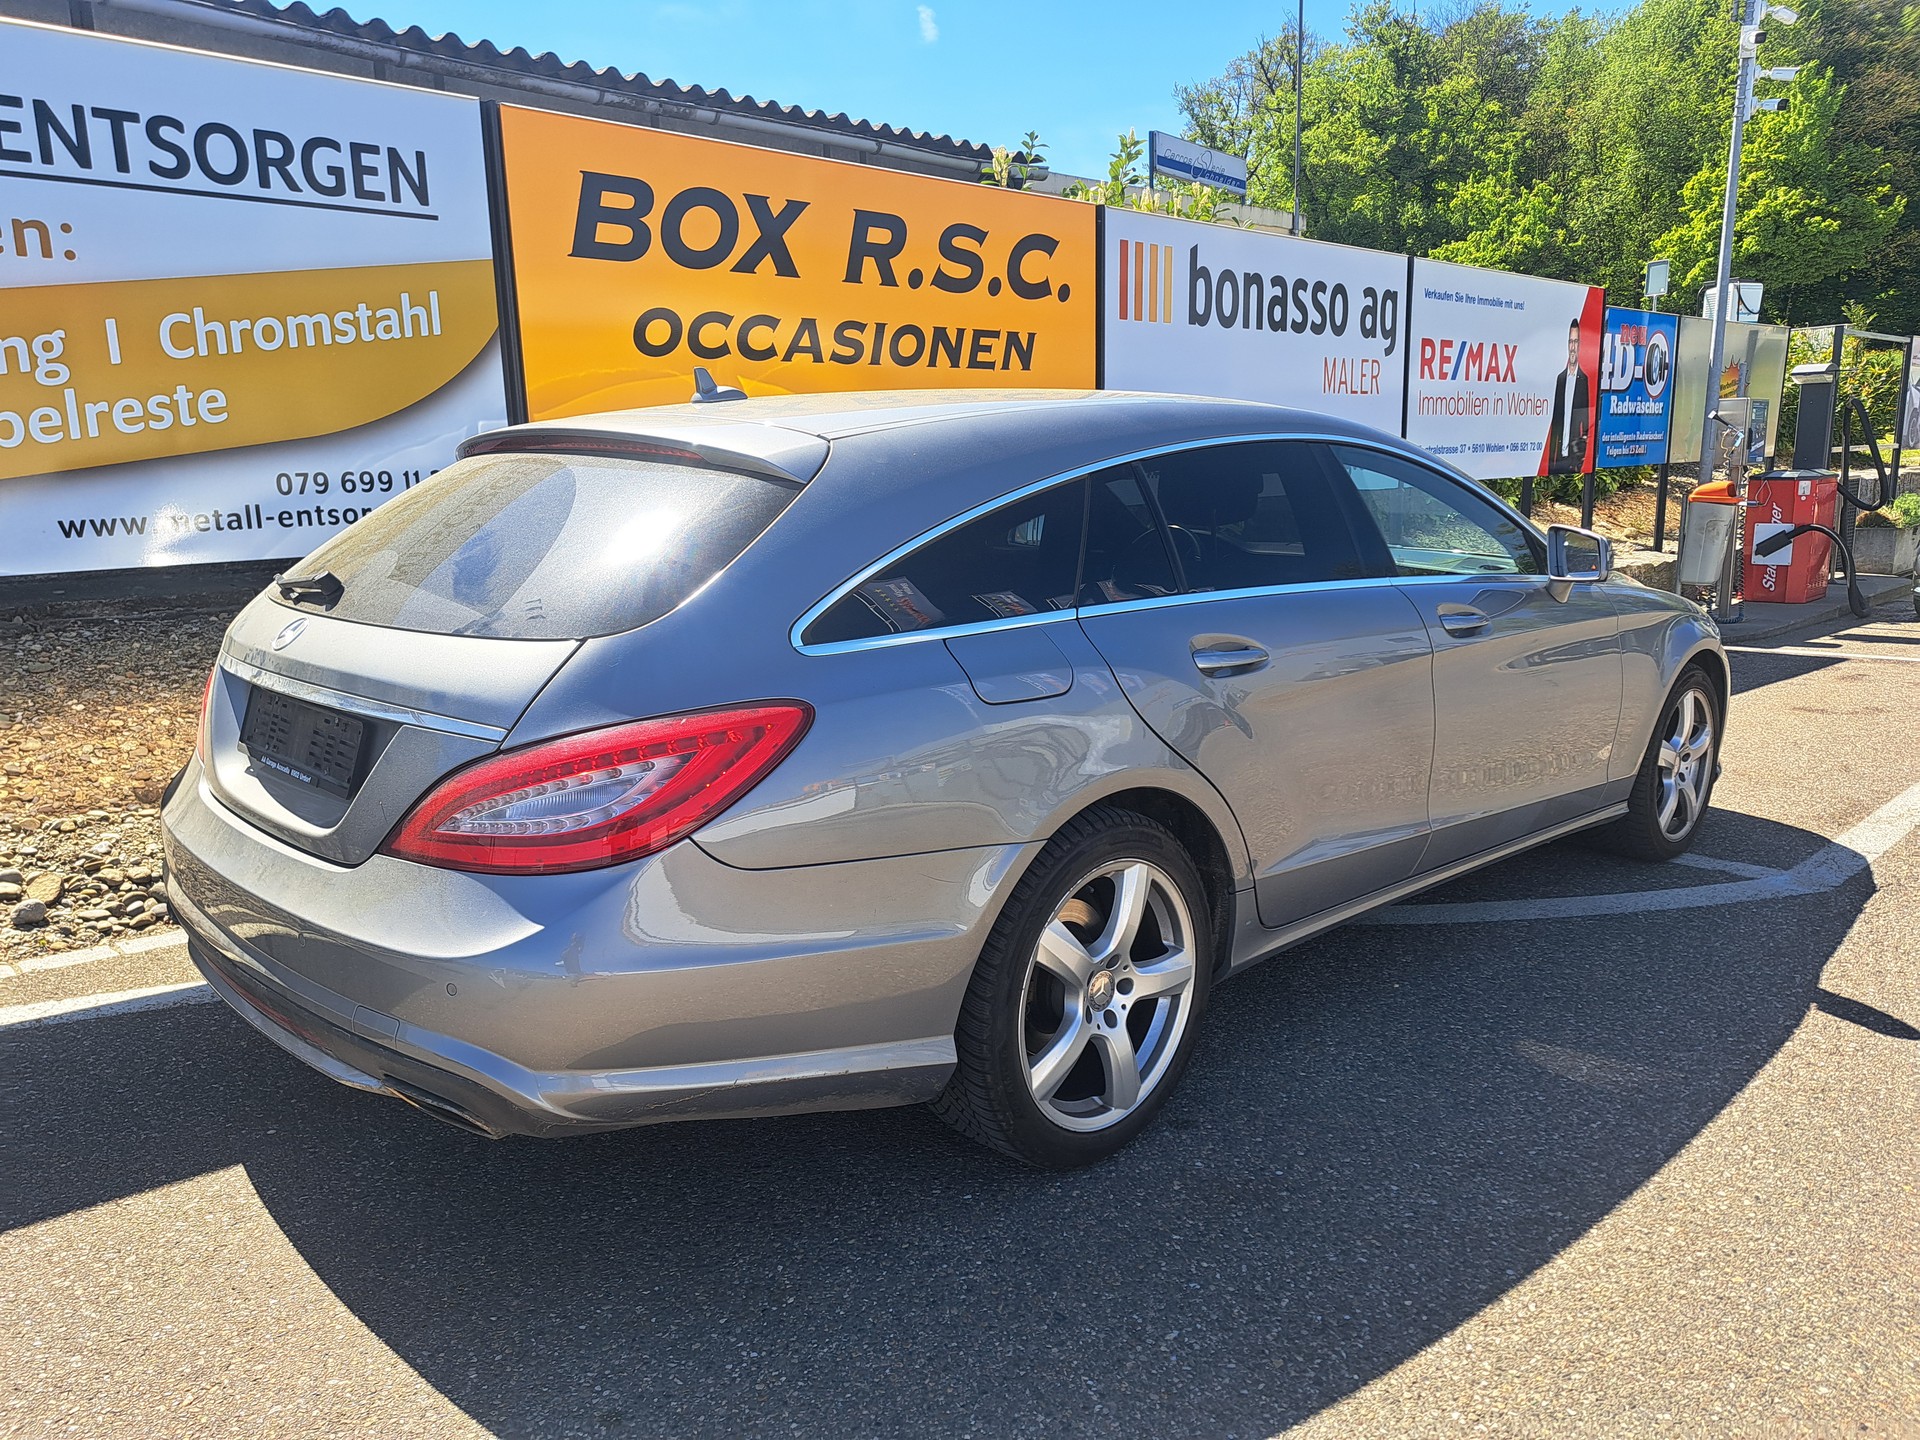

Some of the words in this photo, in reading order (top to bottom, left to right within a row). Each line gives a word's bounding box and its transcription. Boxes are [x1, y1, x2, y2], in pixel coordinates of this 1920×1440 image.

[0, 217, 77, 260] n:
[568, 170, 811, 278] BOX
[842, 208, 1071, 302] R.S.C.
[1188, 243, 1348, 336] bonasso
[1360, 286, 1400, 357] ag
[1424, 288, 1453, 302] Verkaufen
[1454, 291, 1464, 303] Sie
[1464, 293, 1476, 305] Ihre
[1477, 295, 1503, 308] Immobilie
[1503, 299, 1513, 309] mit
[1513, 301, 1525, 310] uns!
[158, 290, 443, 359] Chromstahl
[633, 307, 1037, 371] OCCASIONEN
[1620, 323, 1647, 346] neu
[1322, 357, 1381, 396] MALER
[1420, 338, 1518, 383] RE/MAX
[1418, 389, 1489, 416] Immobilien
[1493, 391, 1504, 416] in
[1507, 391, 1549, 416] Wohlen
[1609, 395, 1664, 415] Radwäscher
[1459, 443, 1467, 454] 37
[1472, 442, 1485, 454] 5610
[1486, 441, 1505, 454] Wohlen
[1520, 441, 1529, 452] 521
[1530, 441, 1537, 452] 72
[1602, 432, 1610, 442] der
[276, 472, 330, 496] 079
[340, 470, 394, 494] 699
